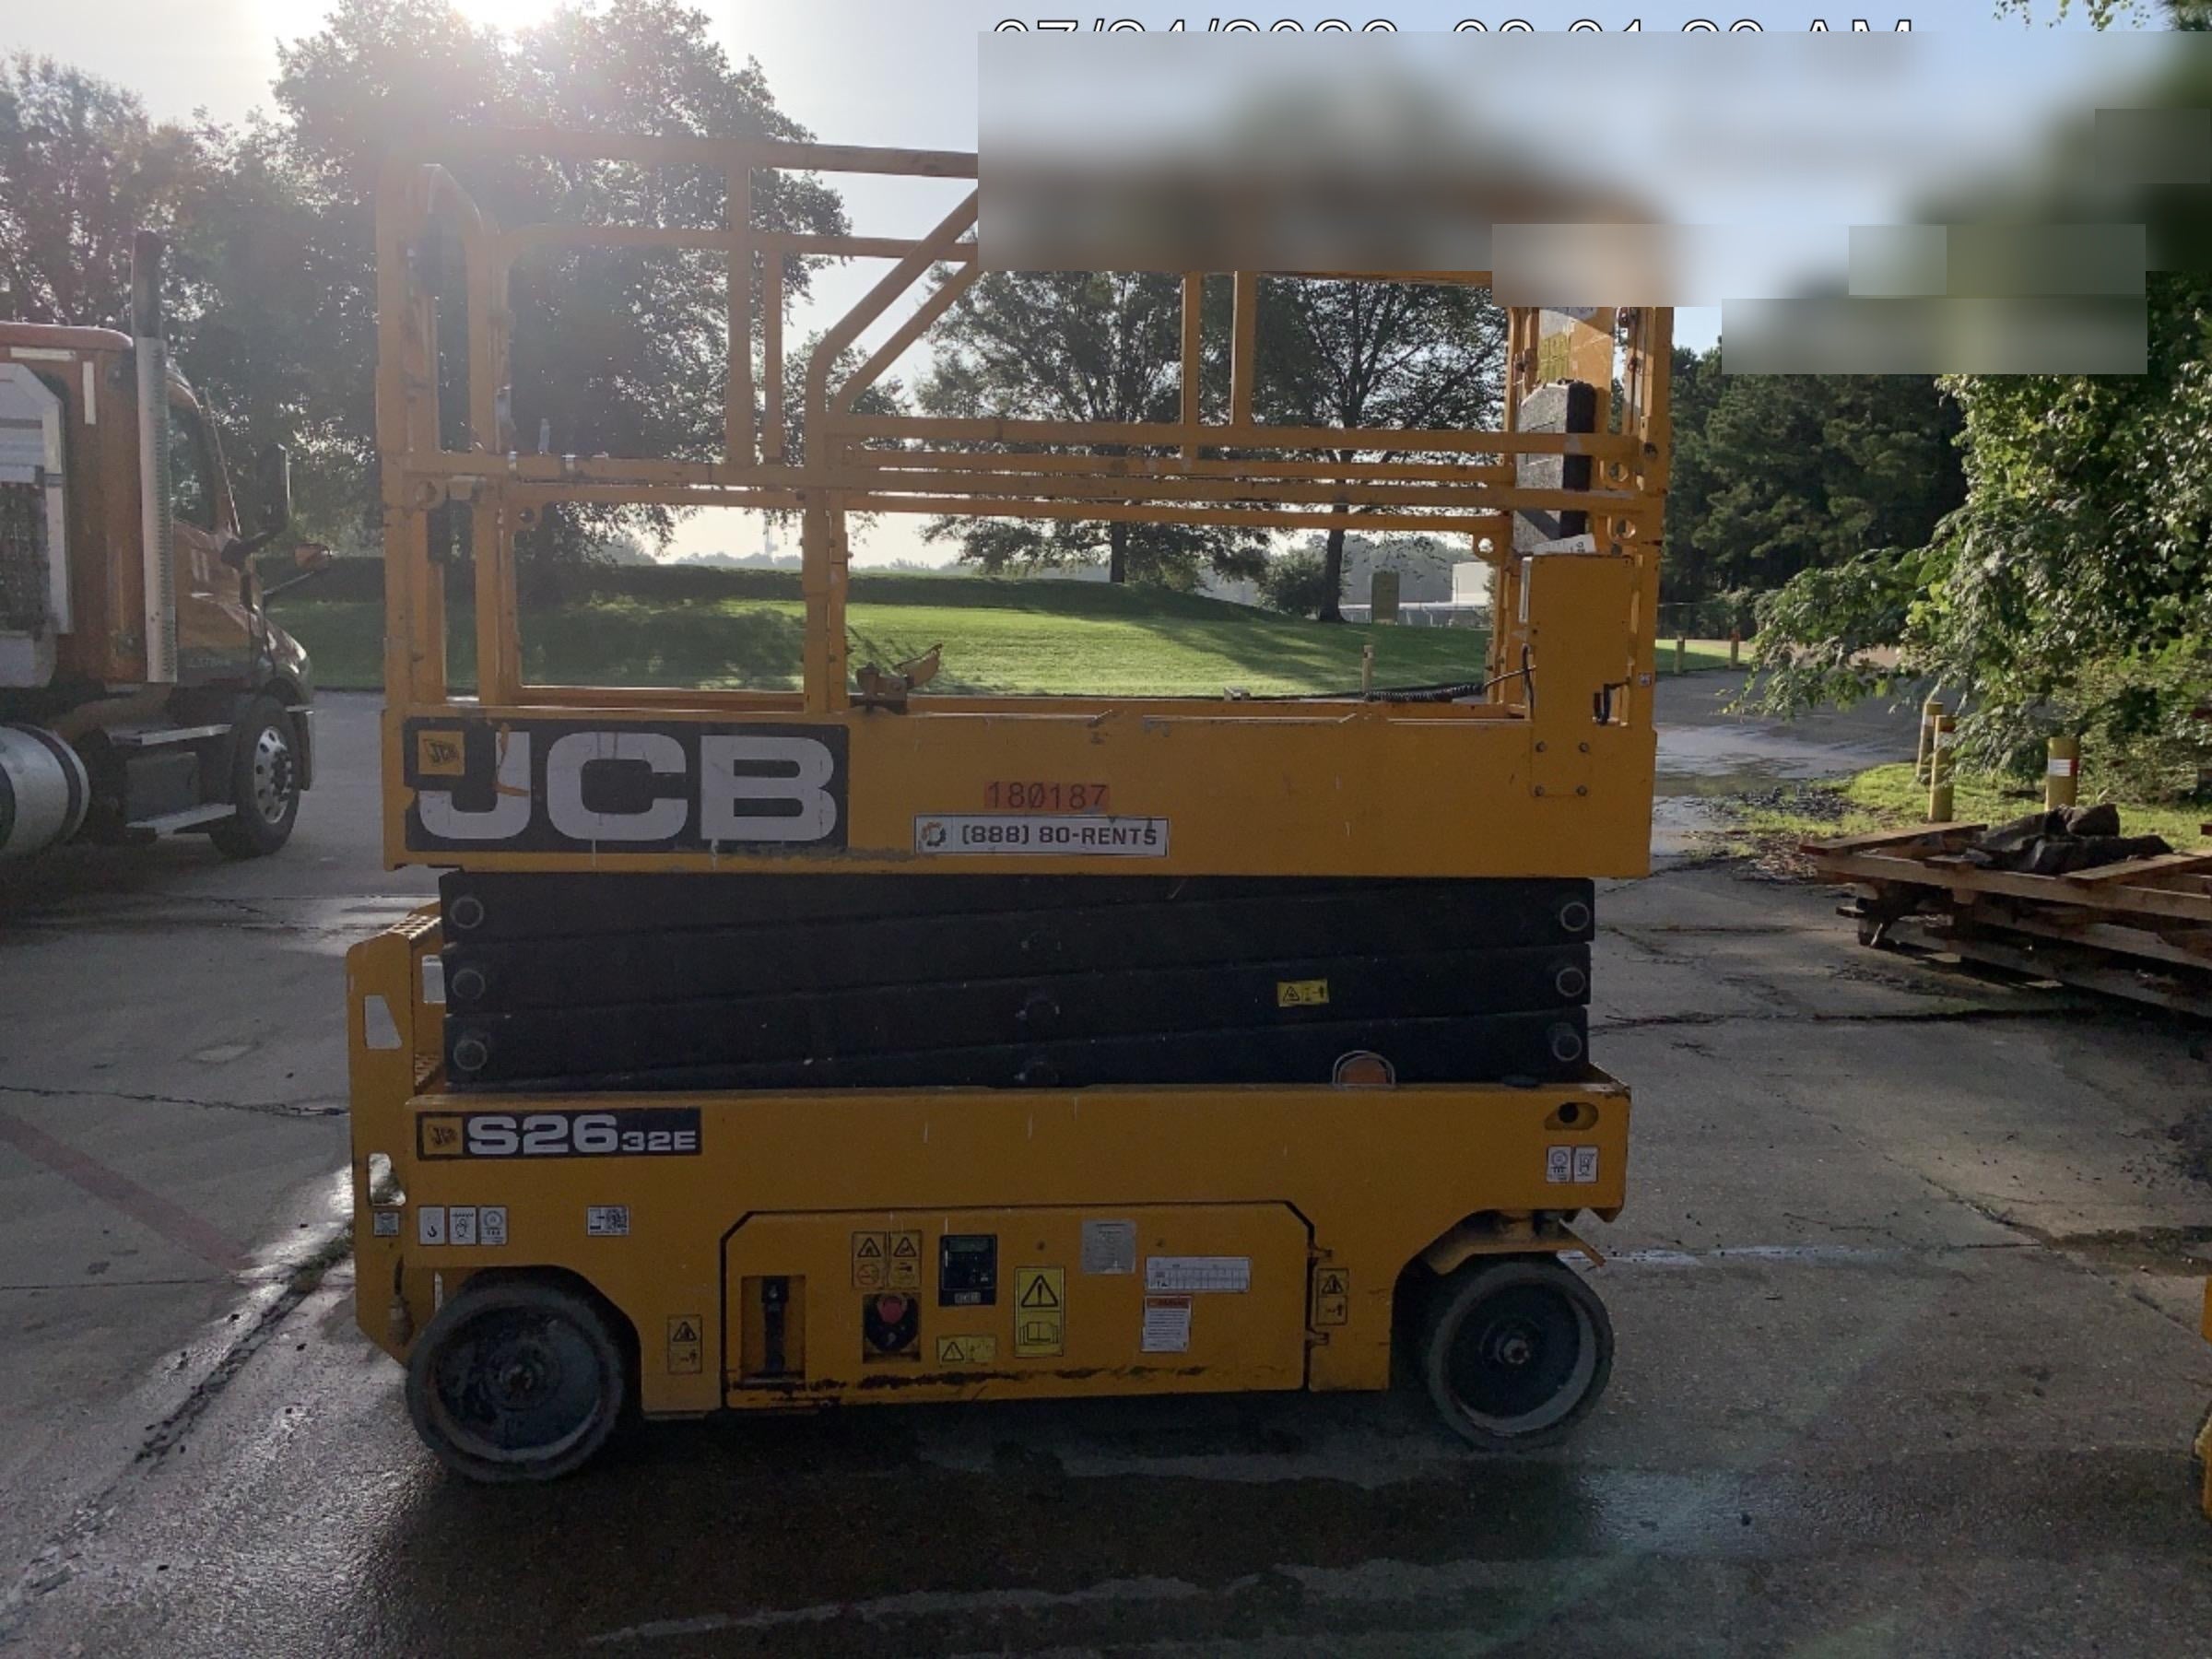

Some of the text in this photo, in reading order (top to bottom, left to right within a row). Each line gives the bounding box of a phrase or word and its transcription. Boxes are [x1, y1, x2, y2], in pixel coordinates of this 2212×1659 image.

[419, 732, 836, 840] JCB
[989, 782, 1107, 809] 180187
[961, 824, 1158, 846] (888) 80-RENTS
